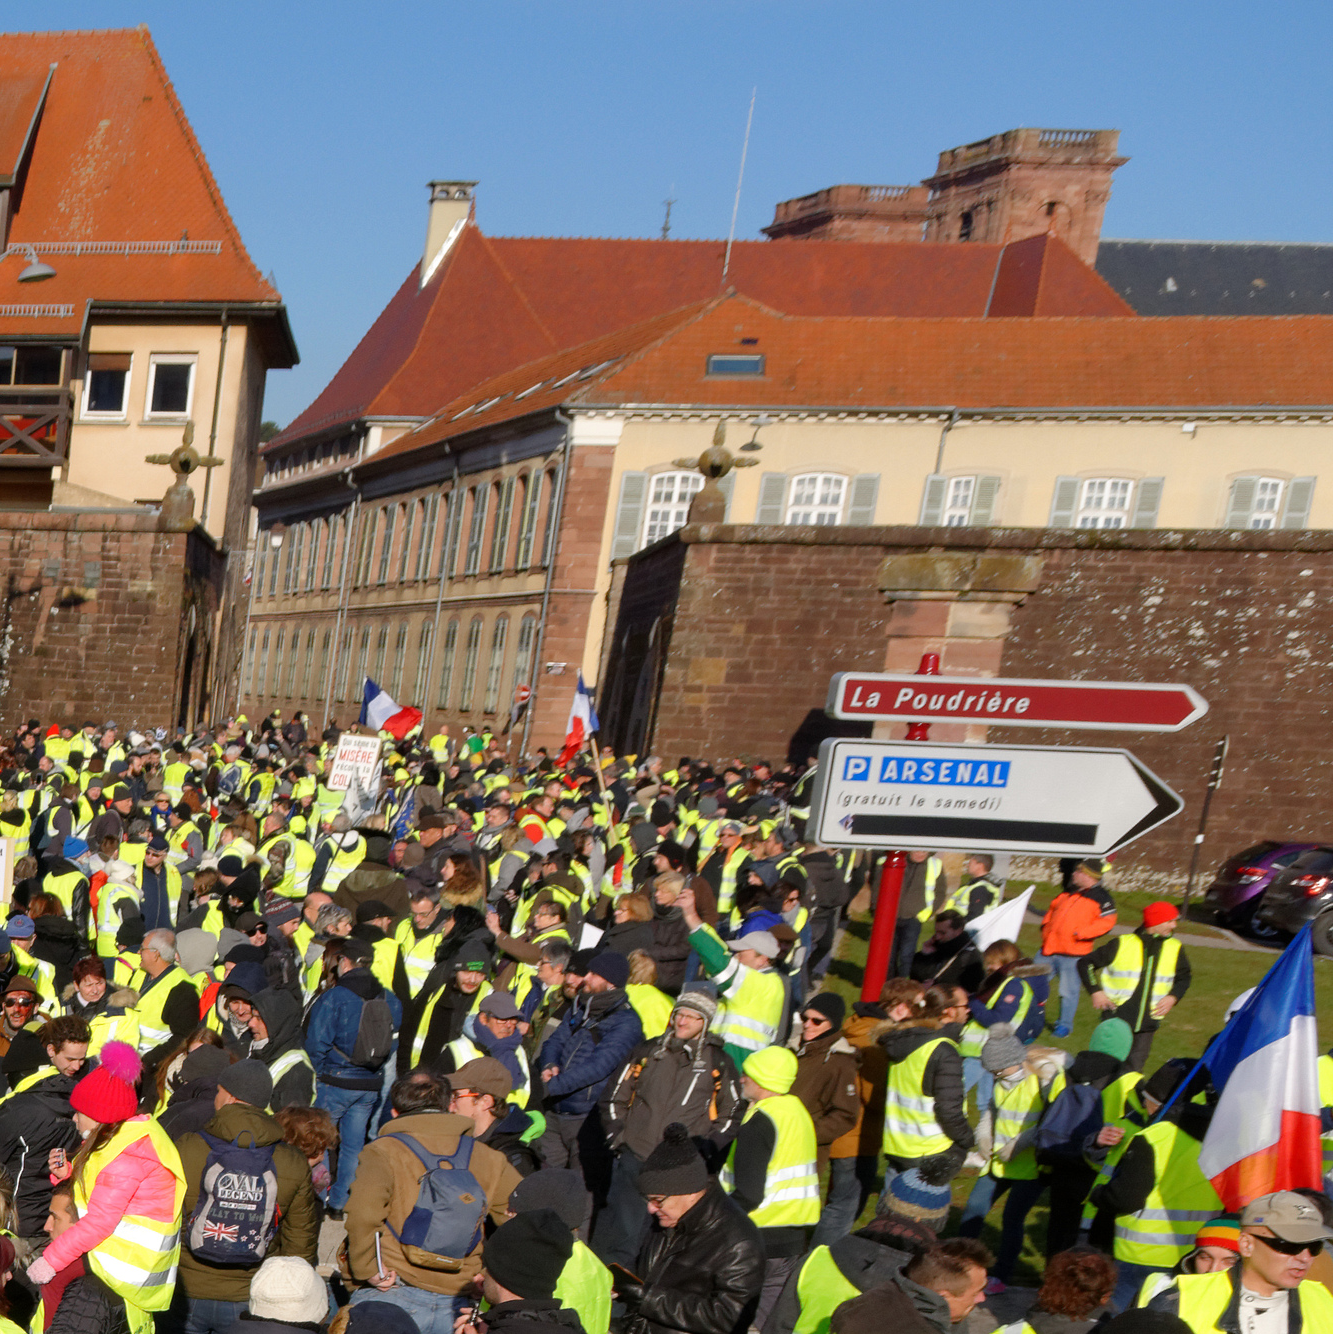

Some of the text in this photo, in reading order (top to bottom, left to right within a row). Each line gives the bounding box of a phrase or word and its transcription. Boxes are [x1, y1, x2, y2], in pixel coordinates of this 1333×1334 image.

[849, 686, 1031, 715] La Poudrière
[338, 747, 375, 764] MISÈRE
[846, 757, 1007, 785] P ARSENAL
[837, 790, 1003, 812] (gratuit le samedi)
[218, 1173, 264, 1193] OVAL
[217, 1189, 263, 1202] LEGEND
